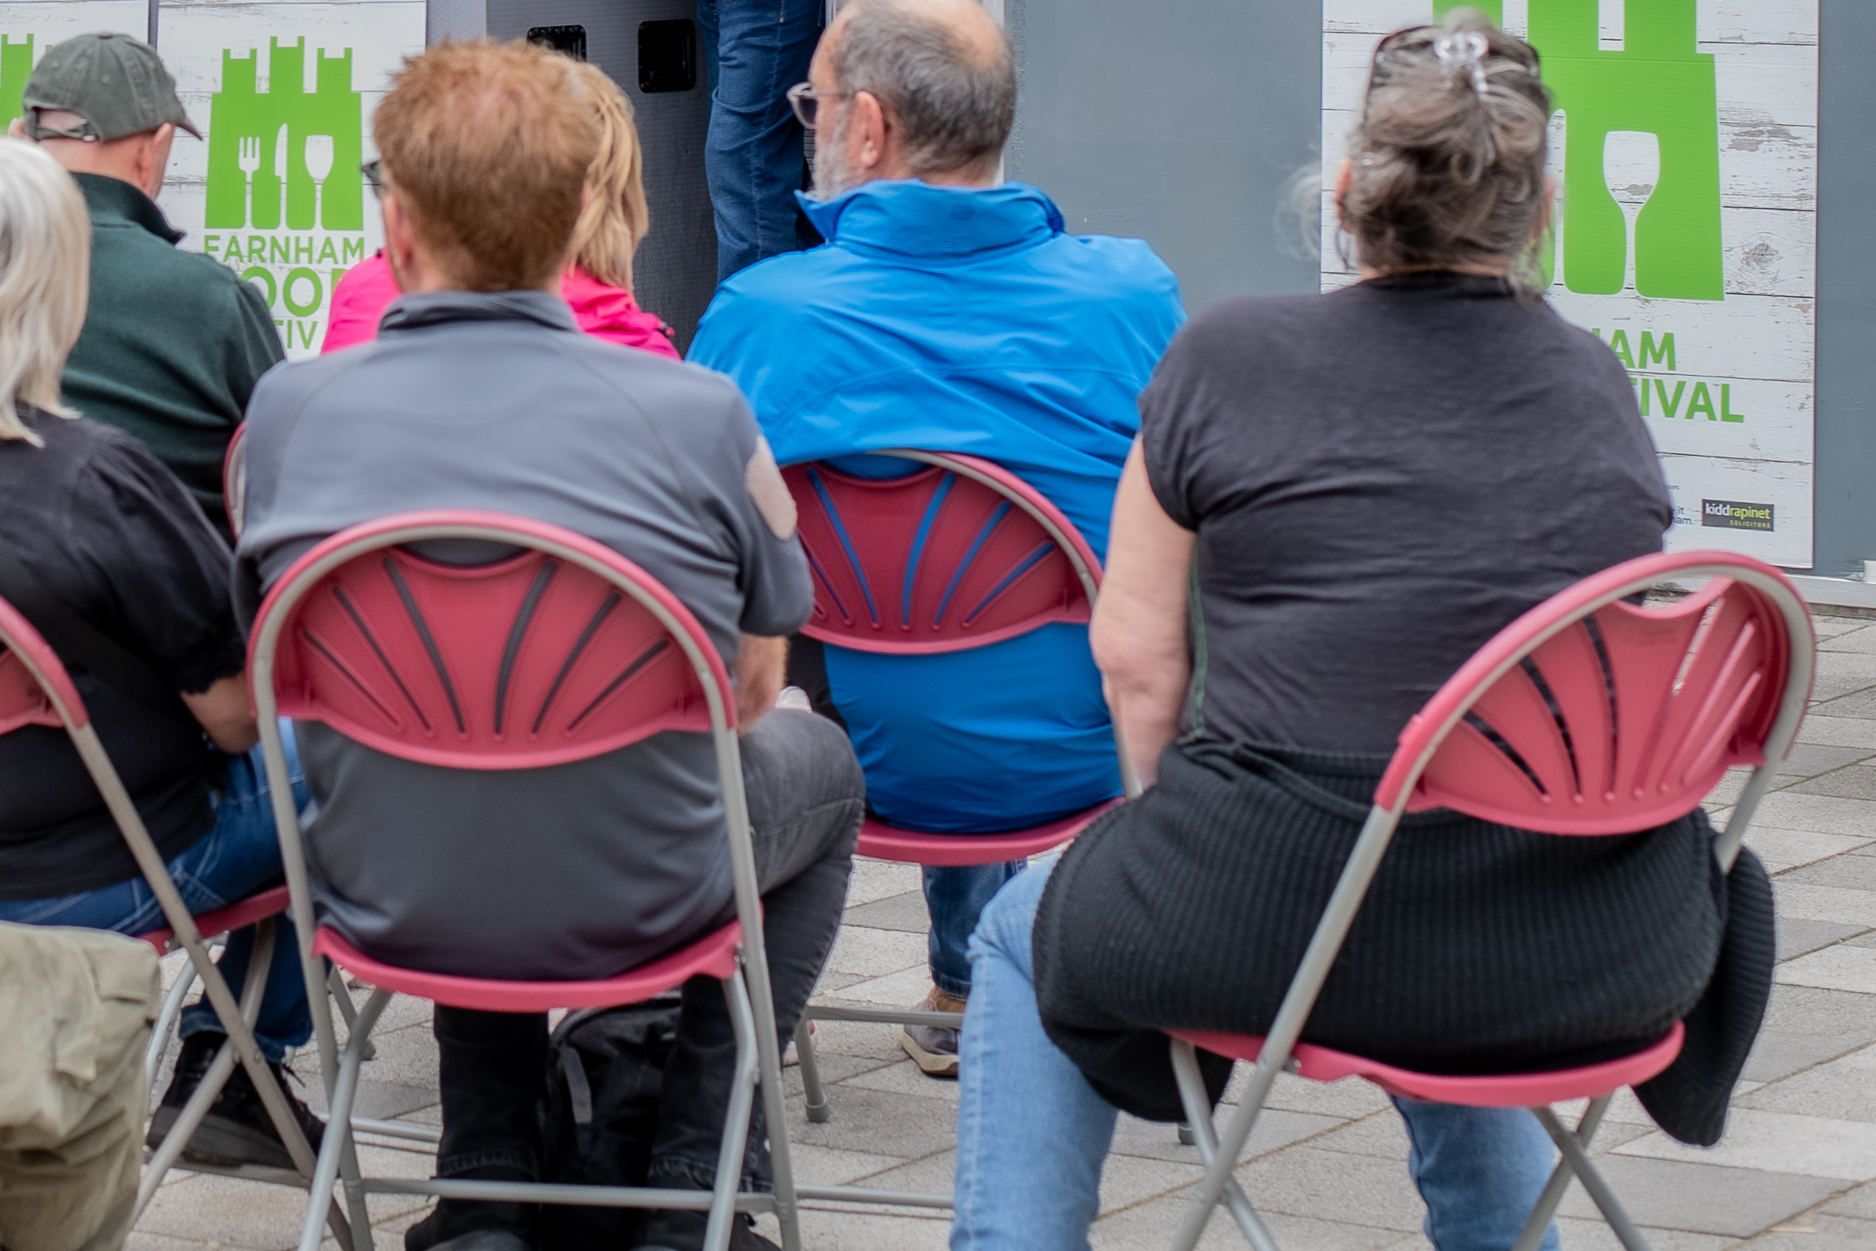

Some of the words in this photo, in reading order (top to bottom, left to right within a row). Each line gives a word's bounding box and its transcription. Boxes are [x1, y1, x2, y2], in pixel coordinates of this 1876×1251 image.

[204, 235, 365, 264] FARNHAM
[1630, 377, 1745, 423] IVAL
[1705, 502, 1771, 520] kiddrapinet
[1729, 519, 1771, 528] SOLICITORS
